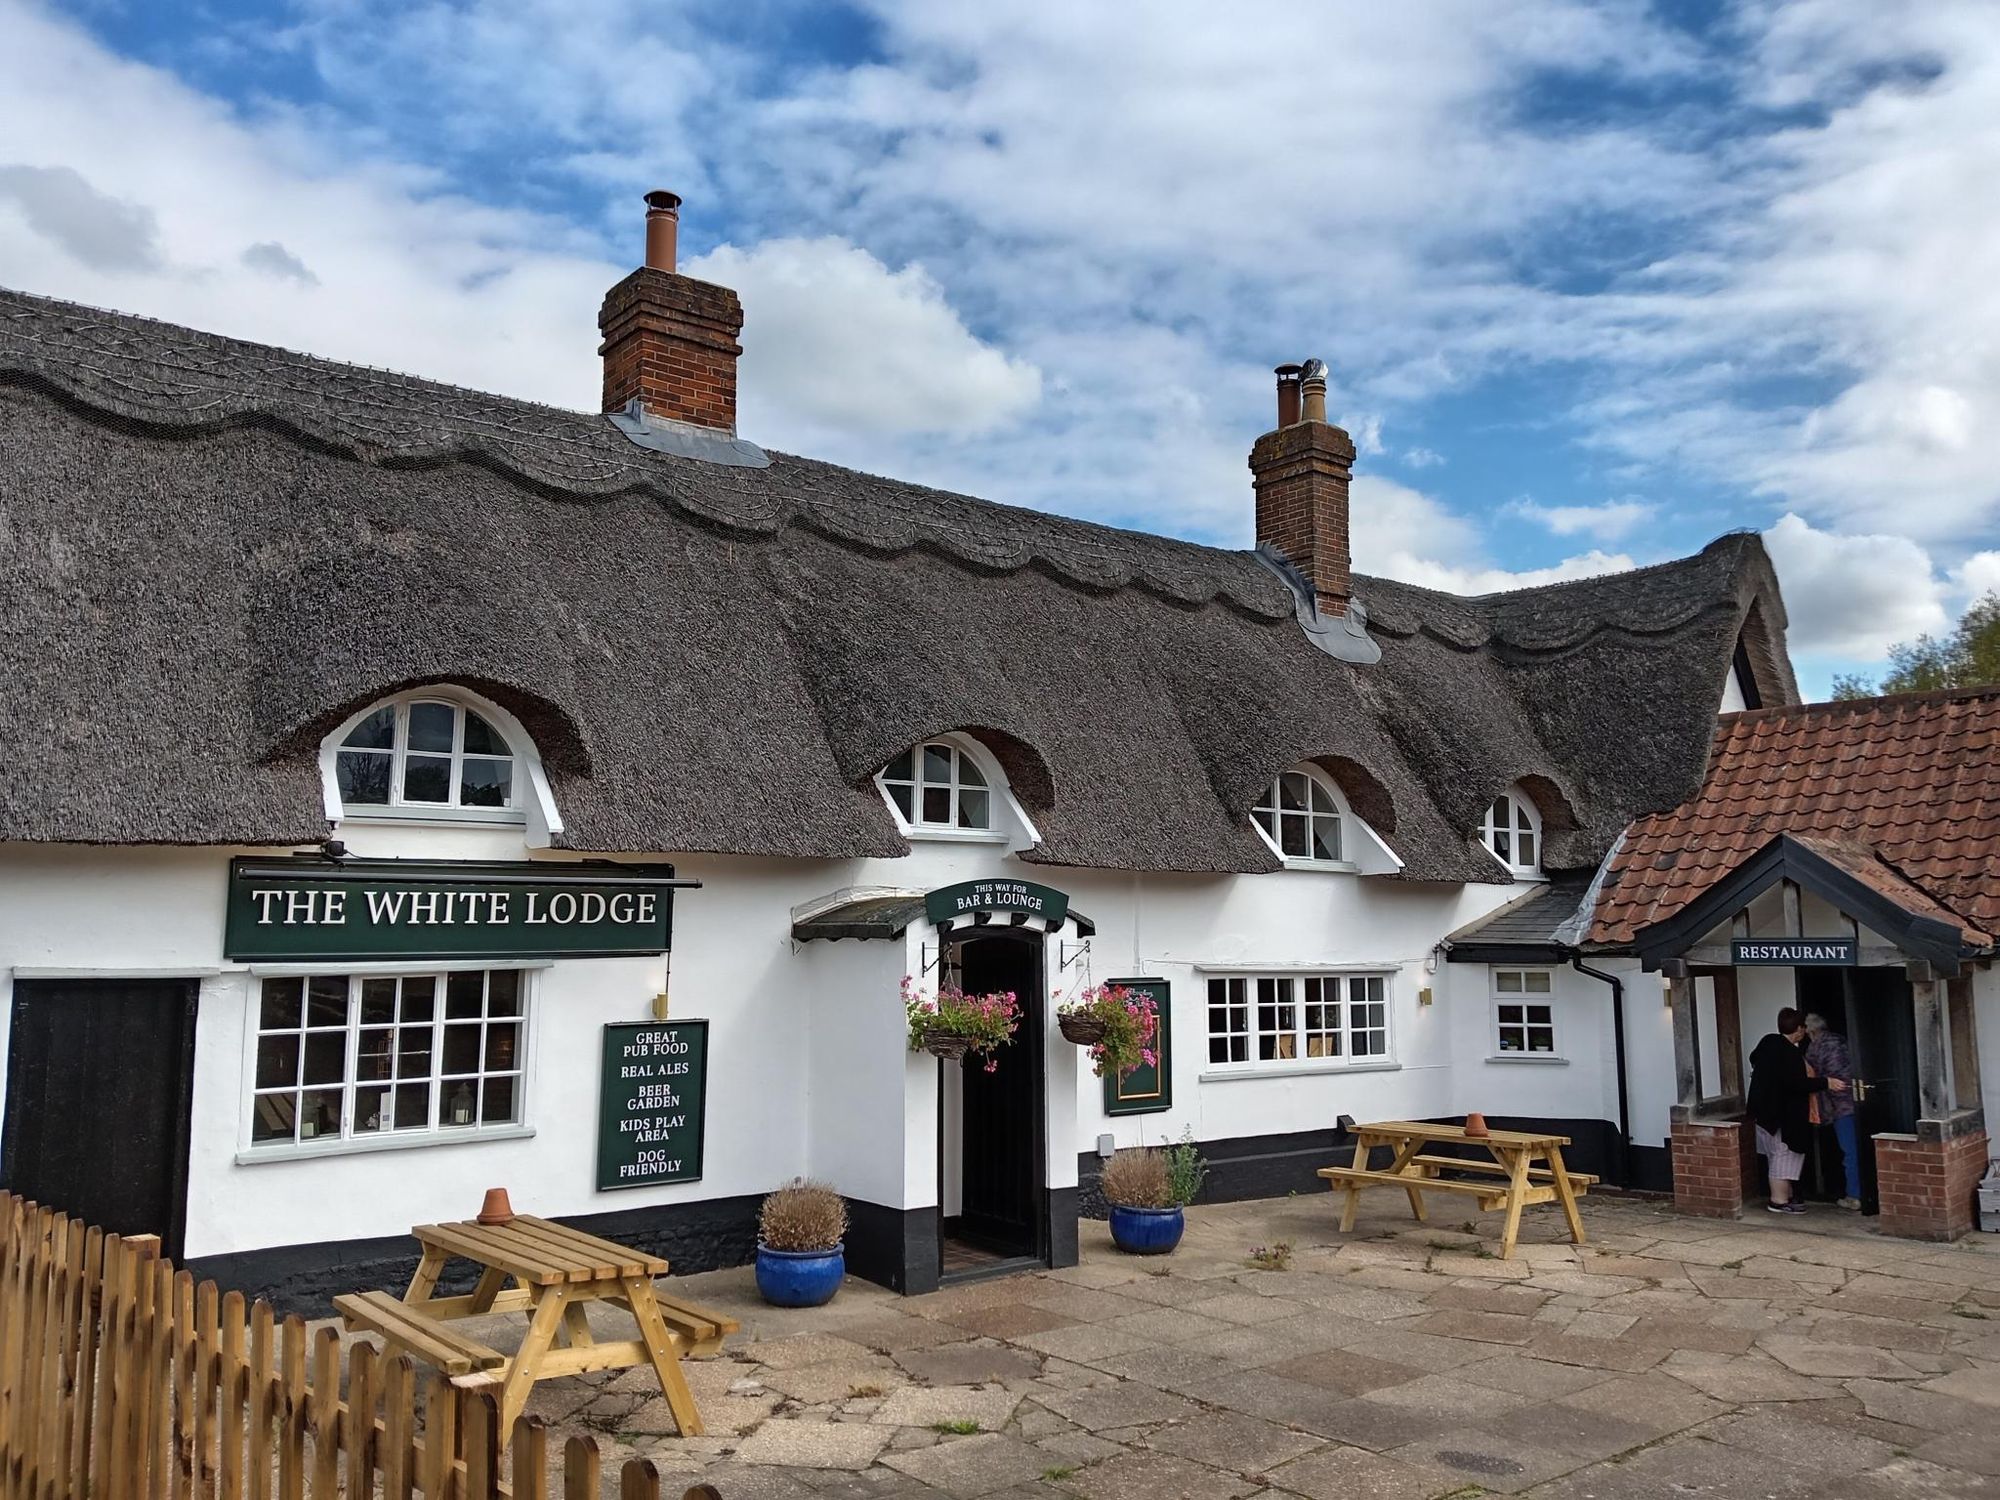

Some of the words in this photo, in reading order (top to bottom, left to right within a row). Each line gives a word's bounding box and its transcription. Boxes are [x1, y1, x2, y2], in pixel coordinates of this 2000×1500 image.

[974, 883, 993, 893] THIS
[995, 883, 1011, 892] WAY
[1012, 884, 1027, 894] FOR
[252, 889, 347, 925] THE
[363, 890, 510, 925] WHITE
[524, 892, 657, 925] LODGE
[956, 894, 980, 910] BAR
[984, 893, 993, 905] &
[996, 892, 1043, 911] LOUNGE
[1739, 946, 1848, 959] RESTAURANT
[636, 1031, 678, 1045] GREAT
[623, 1044, 649, 1057] PUB
[653, 1043, 689, 1056] FOOD
[621, 1065, 654, 1078] REAL
[657, 1062, 689, 1076] ALES
[638, 1084, 671, 1097] BEER
[627, 1096, 680, 1110] GARDEN
[620, 1118, 650, 1132] KIDS
[655, 1115, 686, 1128] PLAY
[635, 1129, 669, 1143] AREA
[637, 1150, 666, 1163] DOG
[619, 1160, 682, 1177] FRIENDLY
